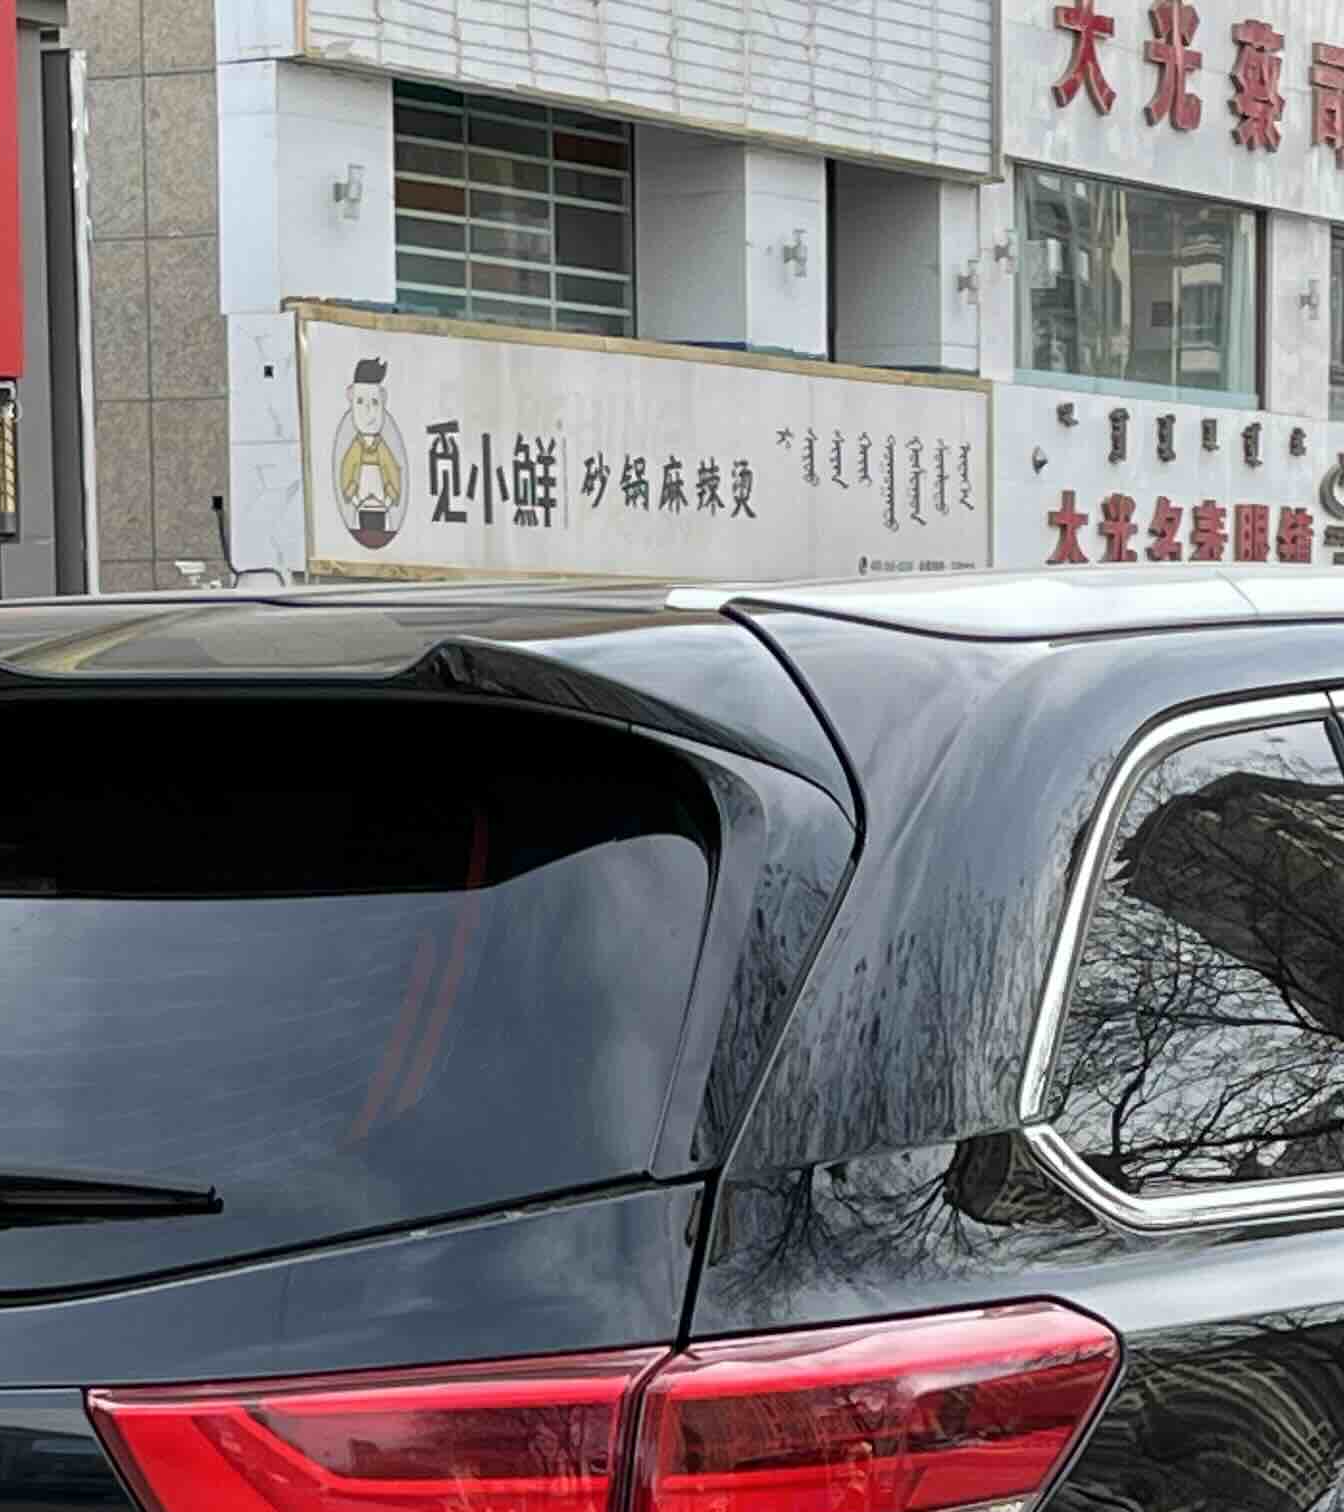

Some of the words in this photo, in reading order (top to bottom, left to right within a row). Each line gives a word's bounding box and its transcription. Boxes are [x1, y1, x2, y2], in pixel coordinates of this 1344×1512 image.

[425, 420, 557, 528] 觅小鲜
[581, 450, 757, 519] 砂锅麻辣烫
